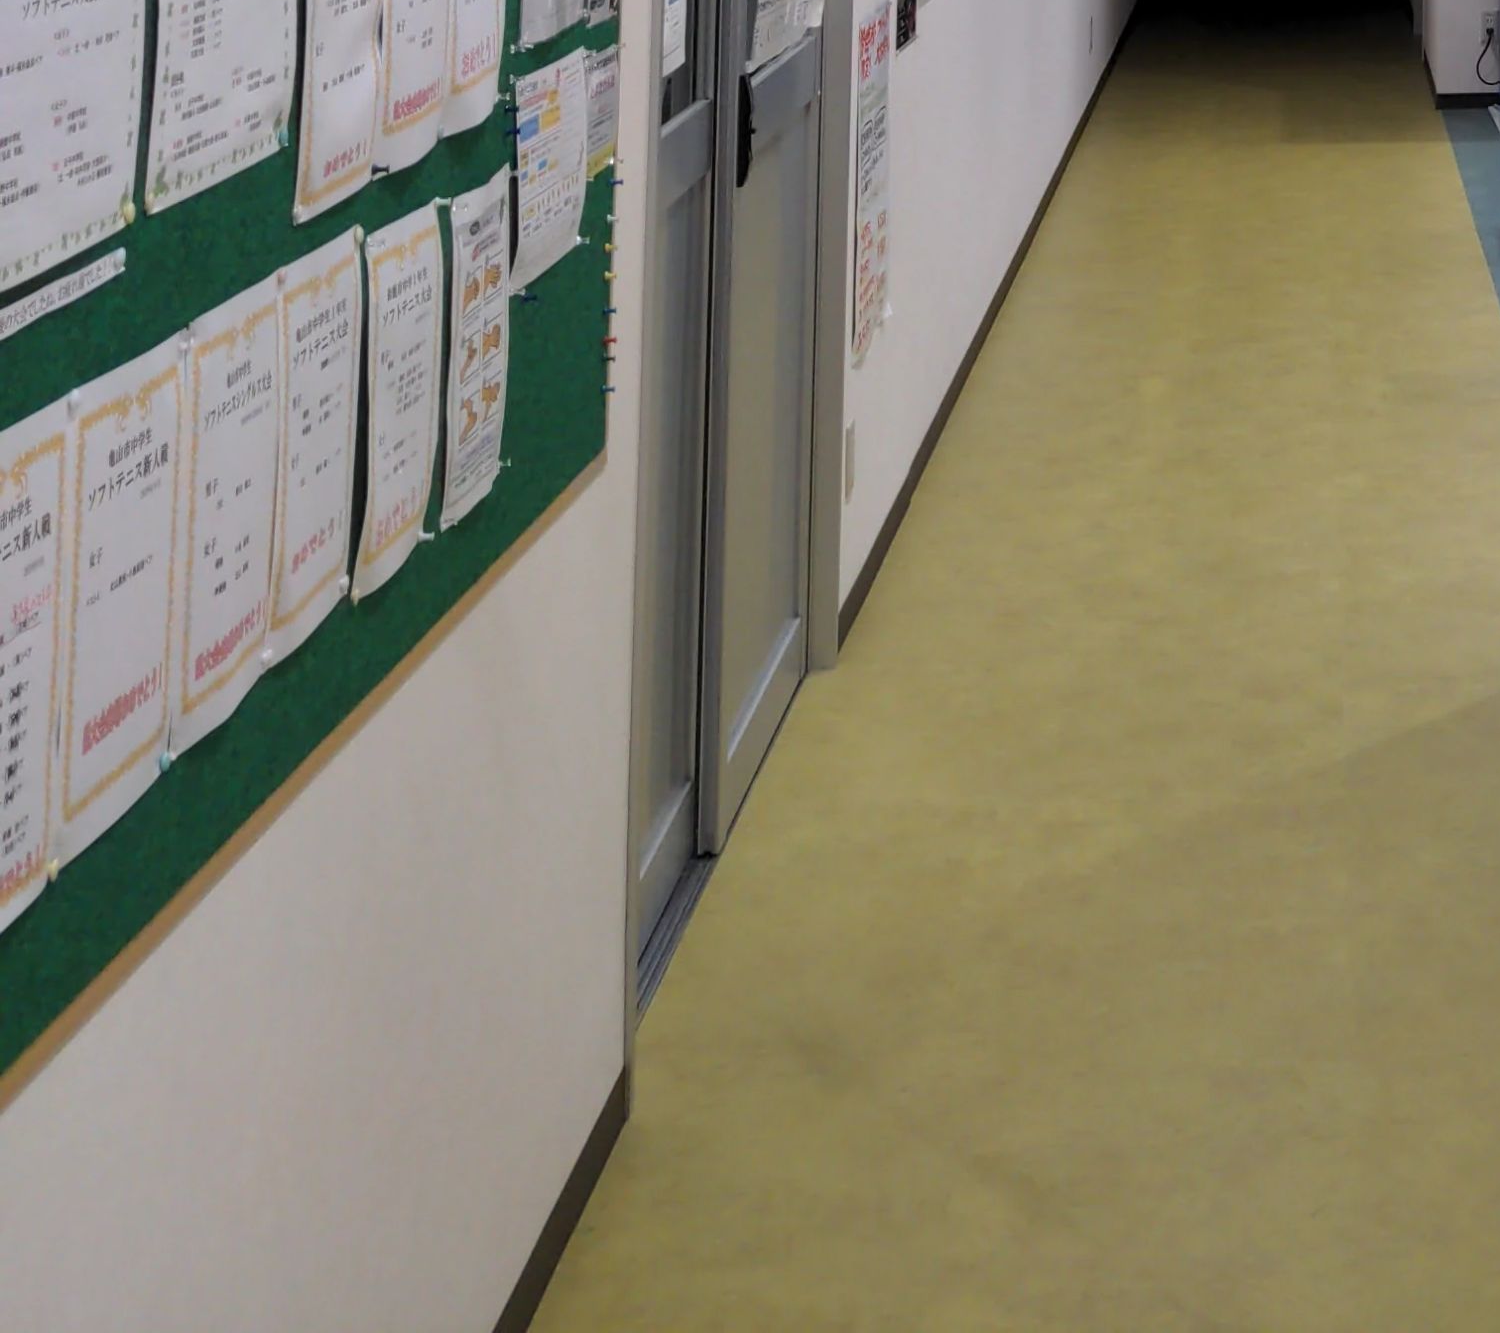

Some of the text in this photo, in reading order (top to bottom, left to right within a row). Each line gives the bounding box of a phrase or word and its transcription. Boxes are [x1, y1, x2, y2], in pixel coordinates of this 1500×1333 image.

[293, 319, 349, 372] ソフトテニス大会
